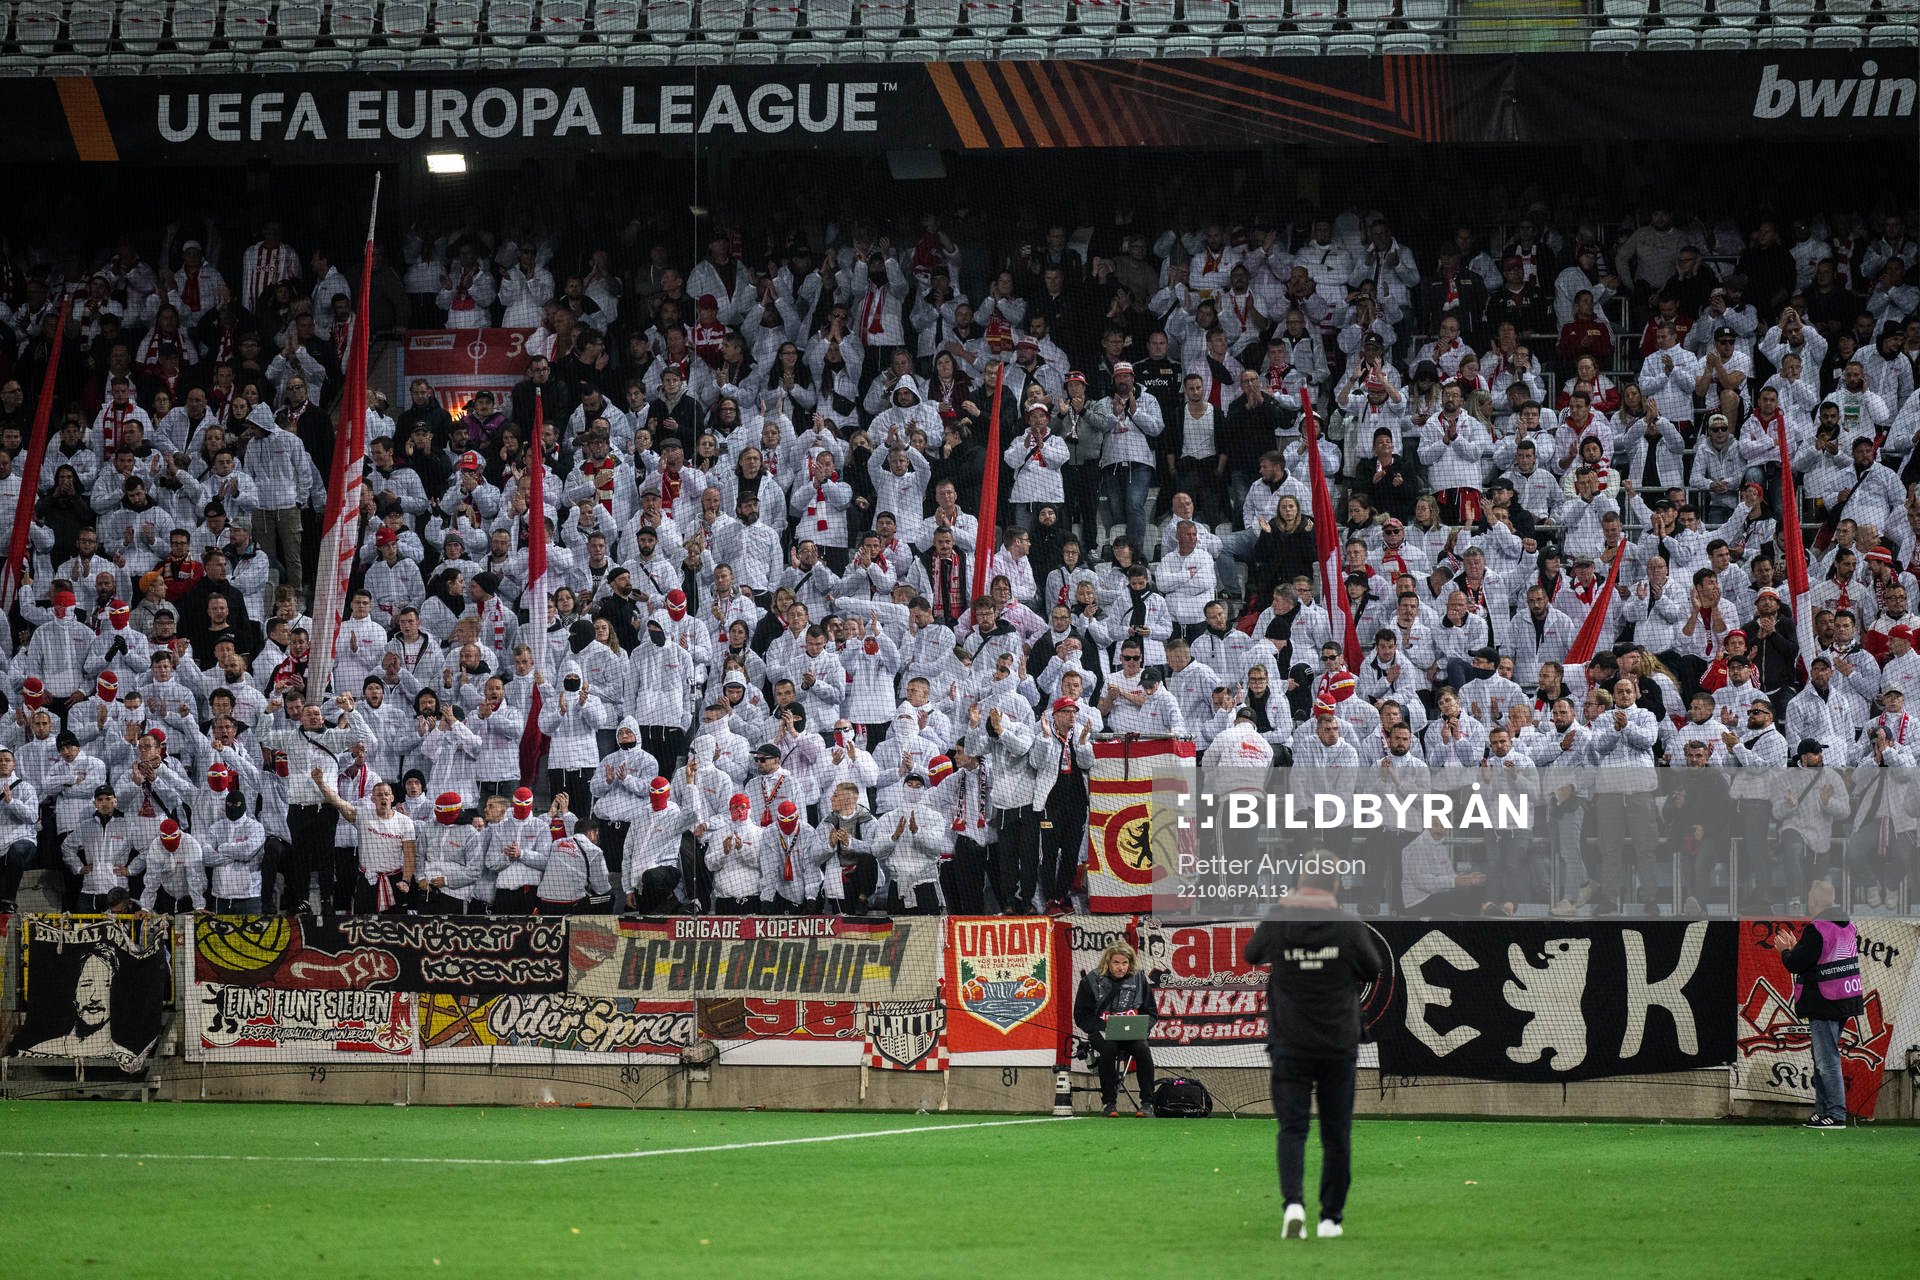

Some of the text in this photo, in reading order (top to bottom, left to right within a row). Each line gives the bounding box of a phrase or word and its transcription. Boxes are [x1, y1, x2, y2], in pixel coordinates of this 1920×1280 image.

[1752, 60, 1917, 119] bwin
[158, 91, 328, 142] UEFA
[347, 87, 602, 140] EUROPA
[674, 917, 835, 939] BRIGADE KÖPENICK
[958, 922, 1048, 957] UNION
[1171, 927, 1272, 979] au
[1820, 966, 1846, 976] VISITING
[225, 985, 271, 1019] EINS
[324, 989, 392, 1024] SIEBEN
[1399, 920, 1709, 1059] E K
[488, 994, 695, 1052] Oder Spree
[866, 1008, 945, 1037] PLATTE
[309, 1066, 326, 1084] 79
[1002, 1067, 1018, 1087] 81
